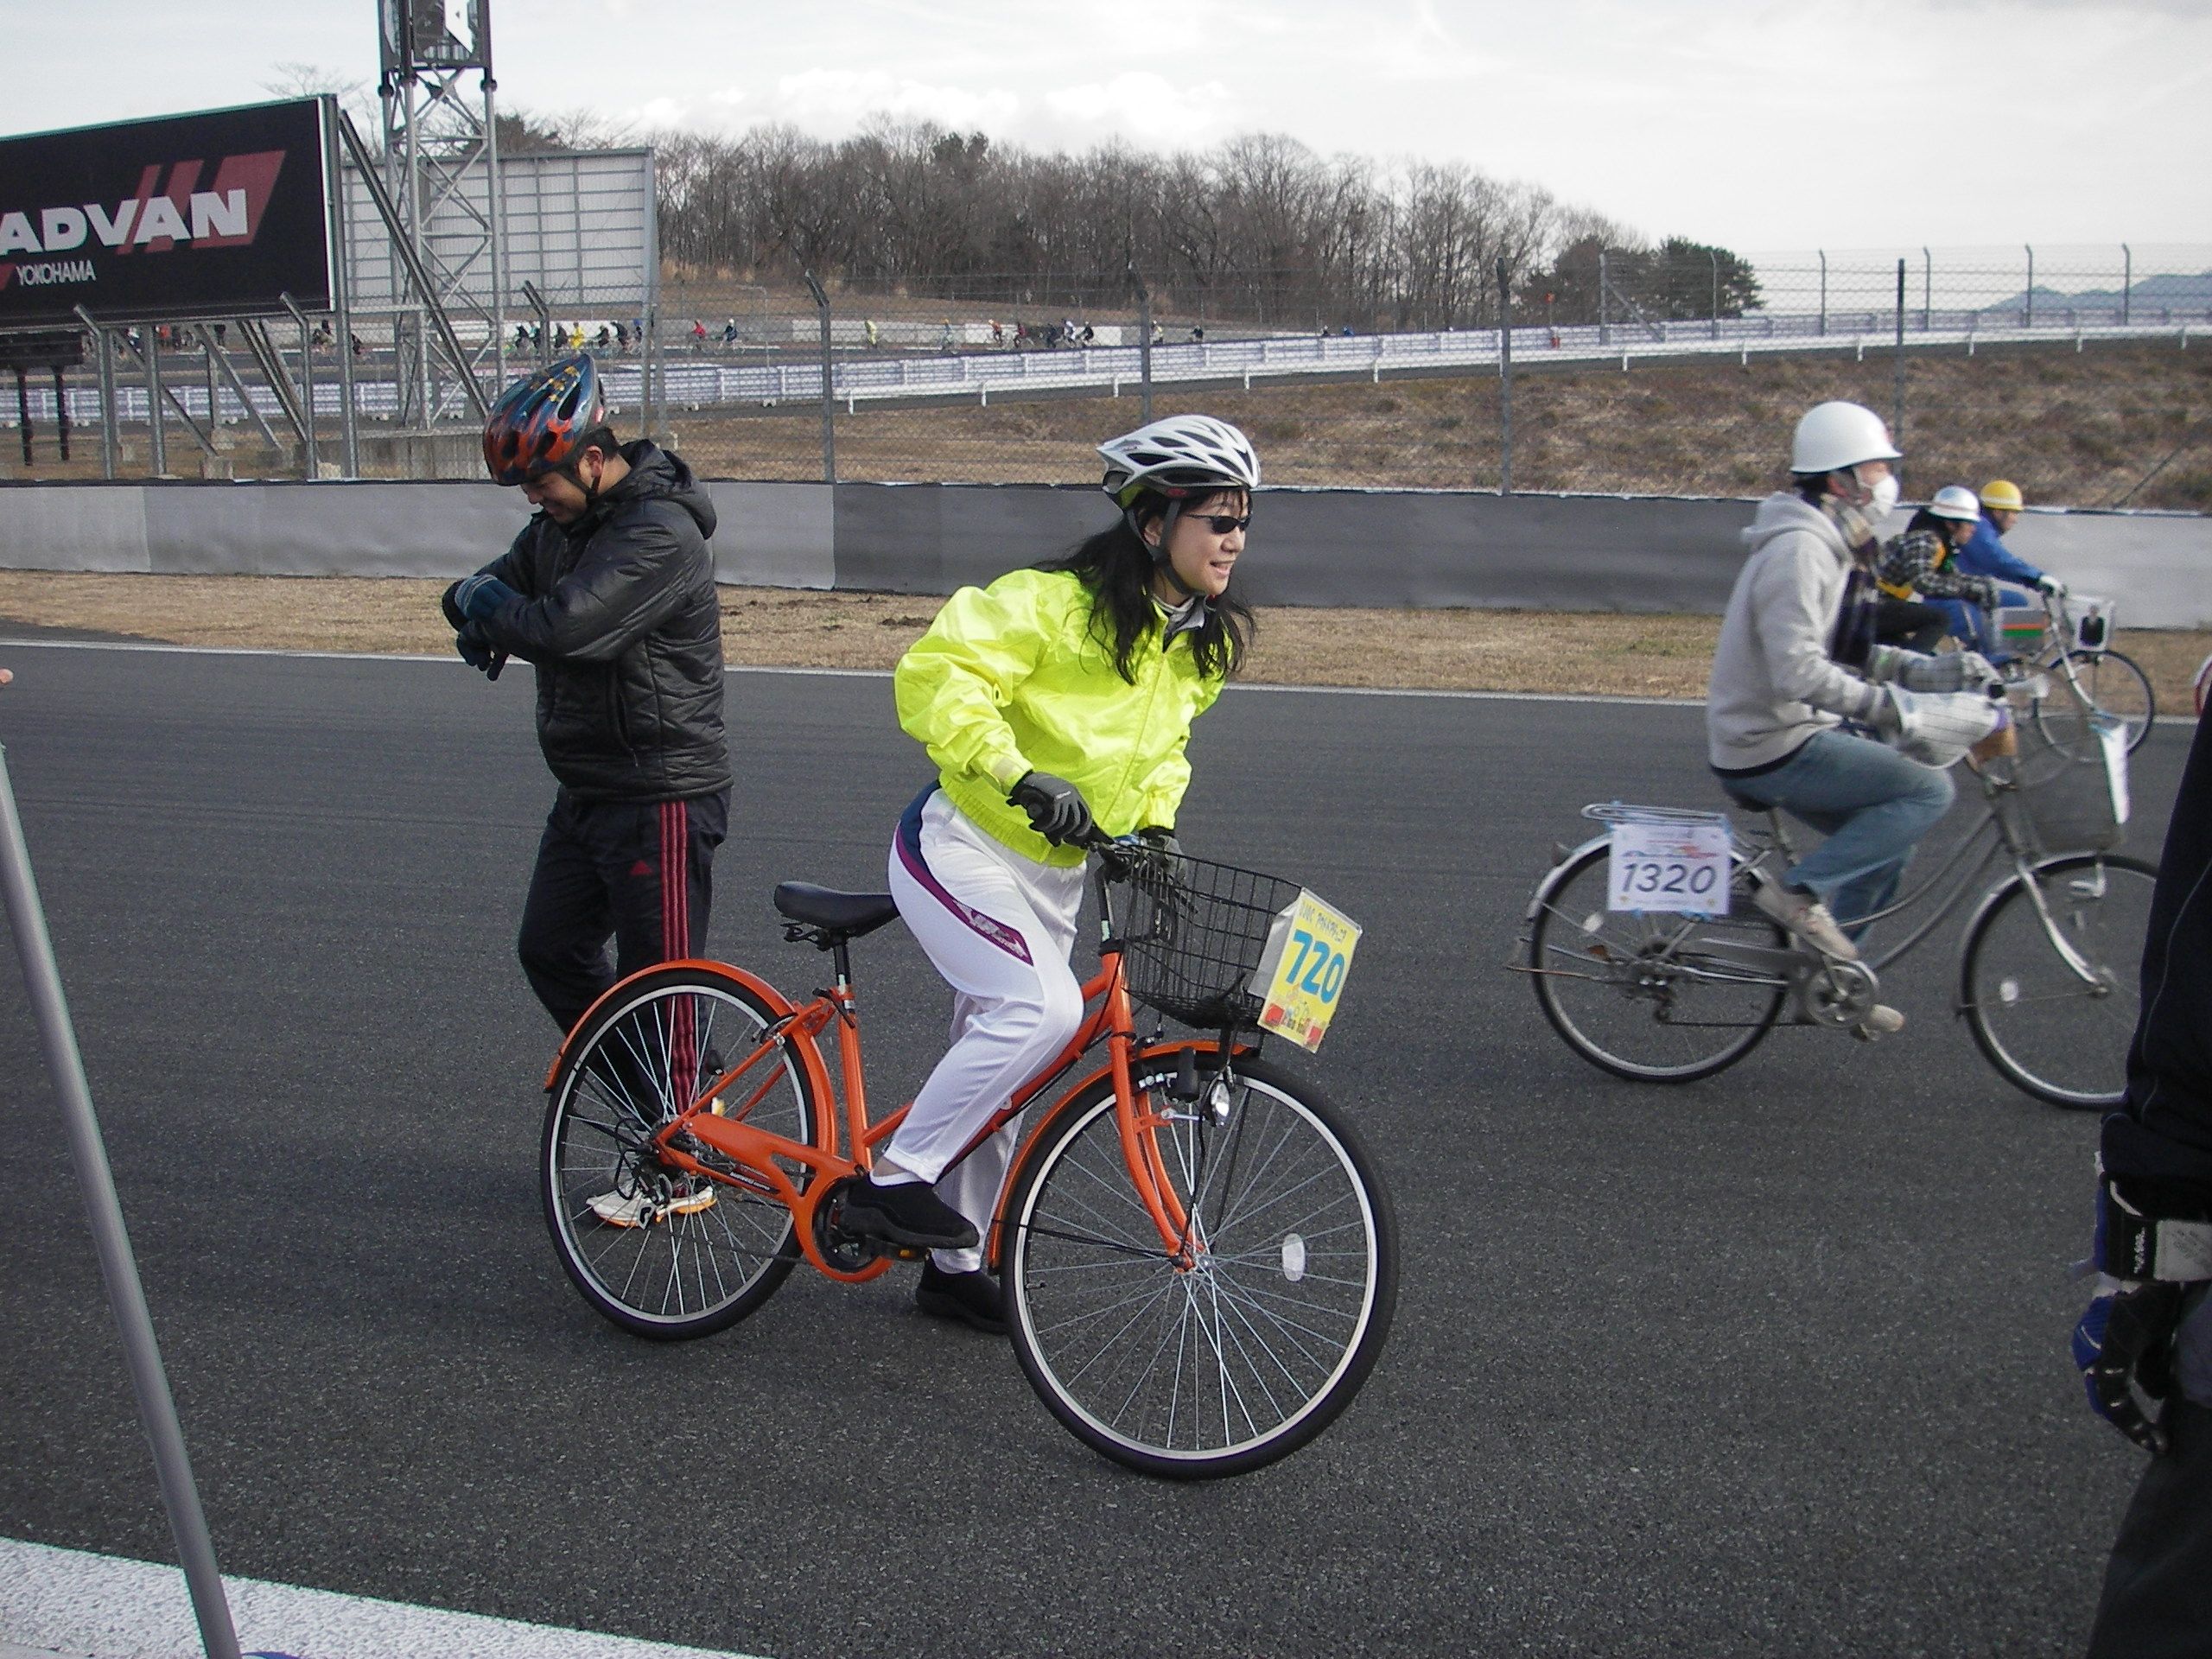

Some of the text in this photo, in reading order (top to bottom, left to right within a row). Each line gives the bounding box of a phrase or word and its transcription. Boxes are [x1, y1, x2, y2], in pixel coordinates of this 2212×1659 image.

[0, 188, 248, 257] ADVAN
[16, 259, 97, 286] YOKOHAMA
[1621, 862, 1717, 893] 1320
[1285, 928, 1345, 1004] 720
